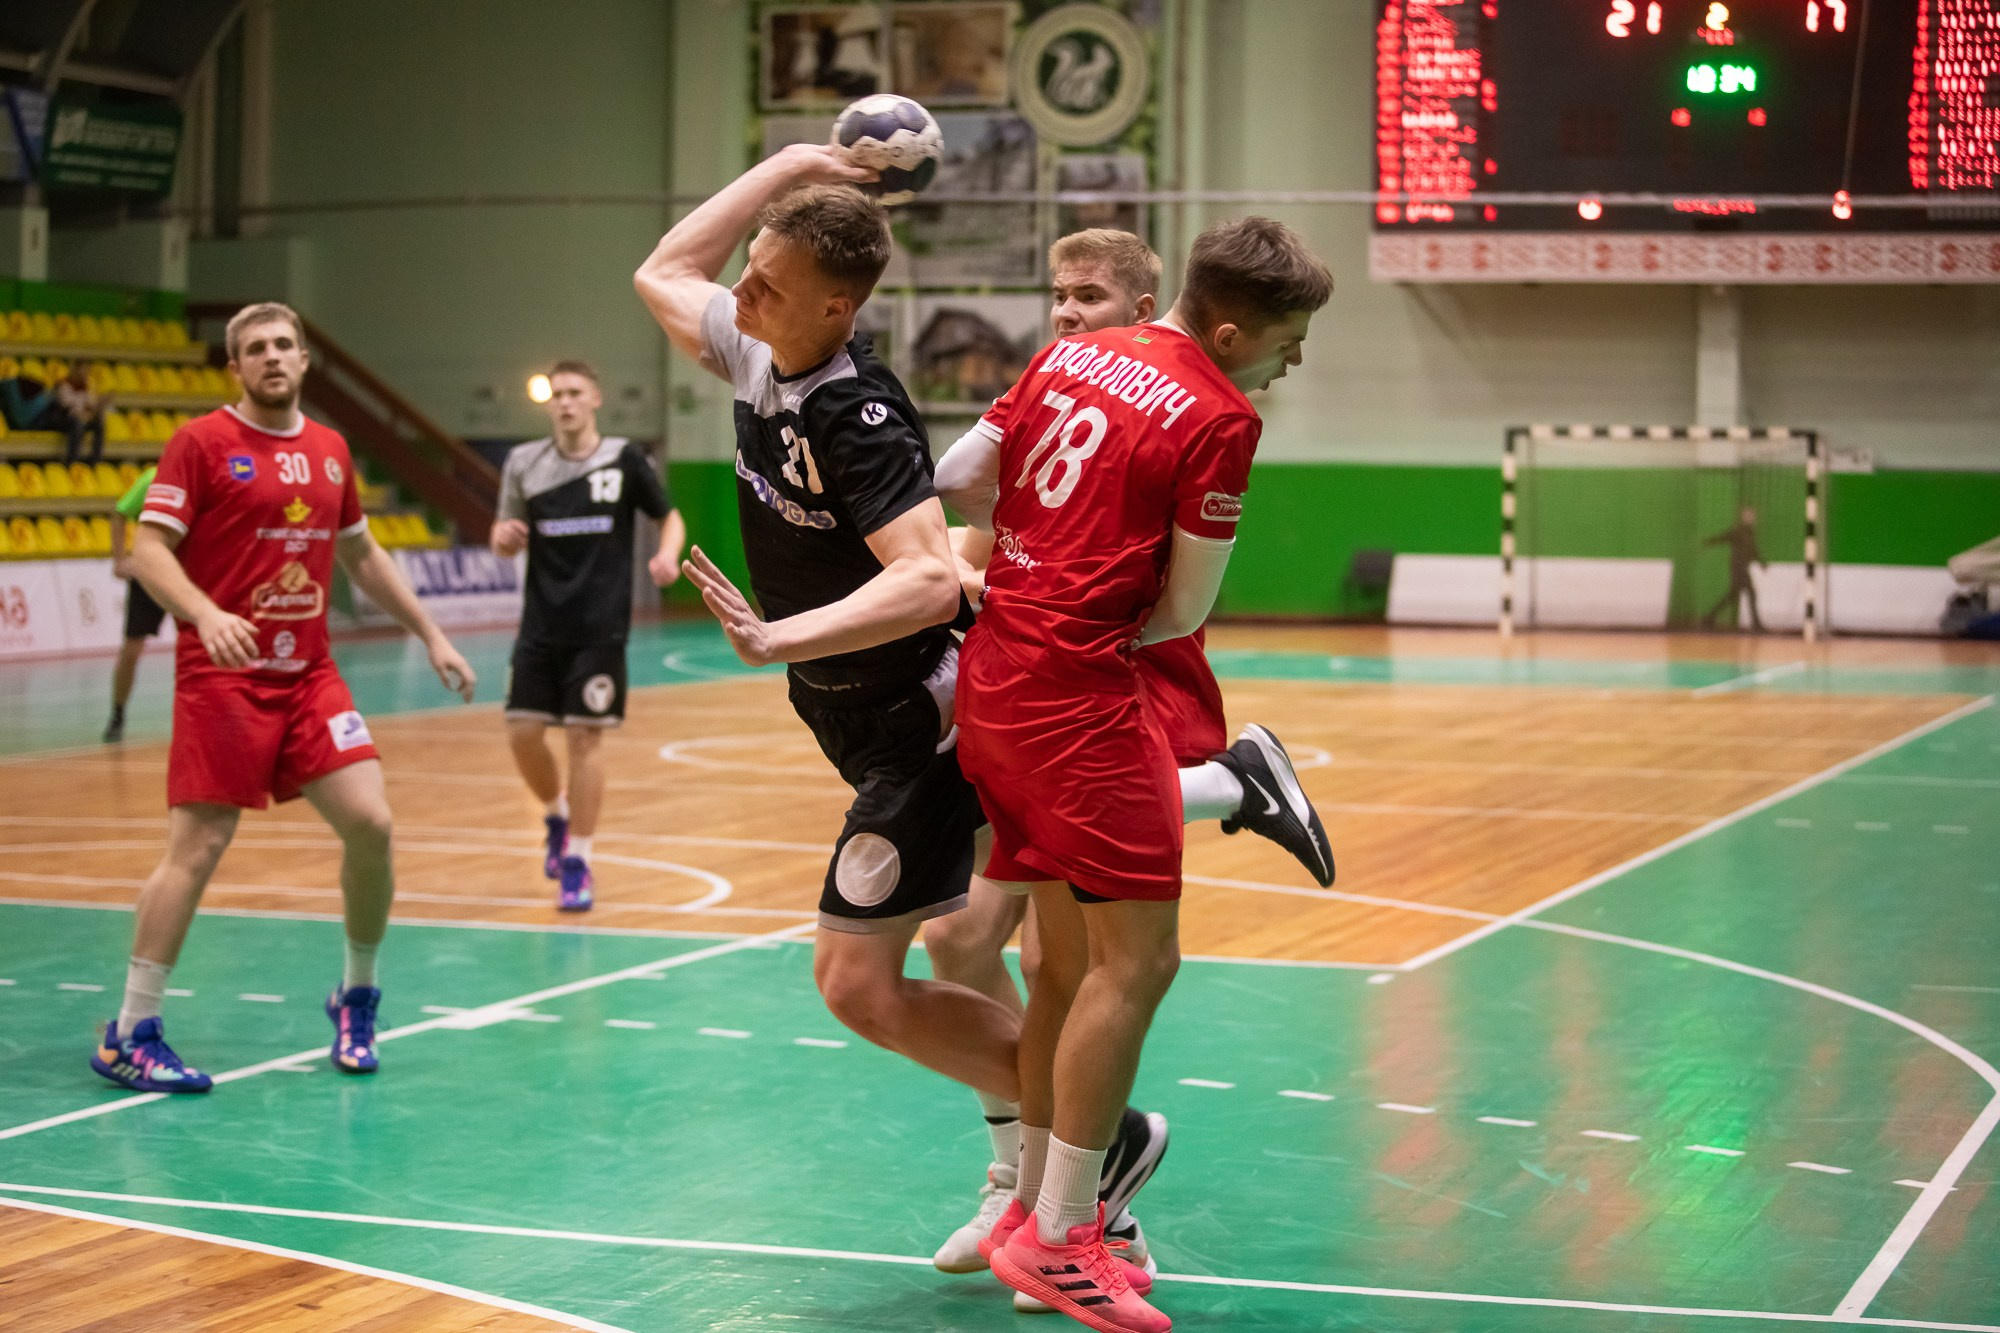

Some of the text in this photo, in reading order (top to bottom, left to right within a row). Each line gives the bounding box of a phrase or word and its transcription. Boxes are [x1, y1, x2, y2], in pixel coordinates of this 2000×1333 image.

[274, 451, 311, 485] 30
[780, 424, 824, 495] 21
[1014, 389, 1108, 509] 78
[588, 468, 623, 503] 13
